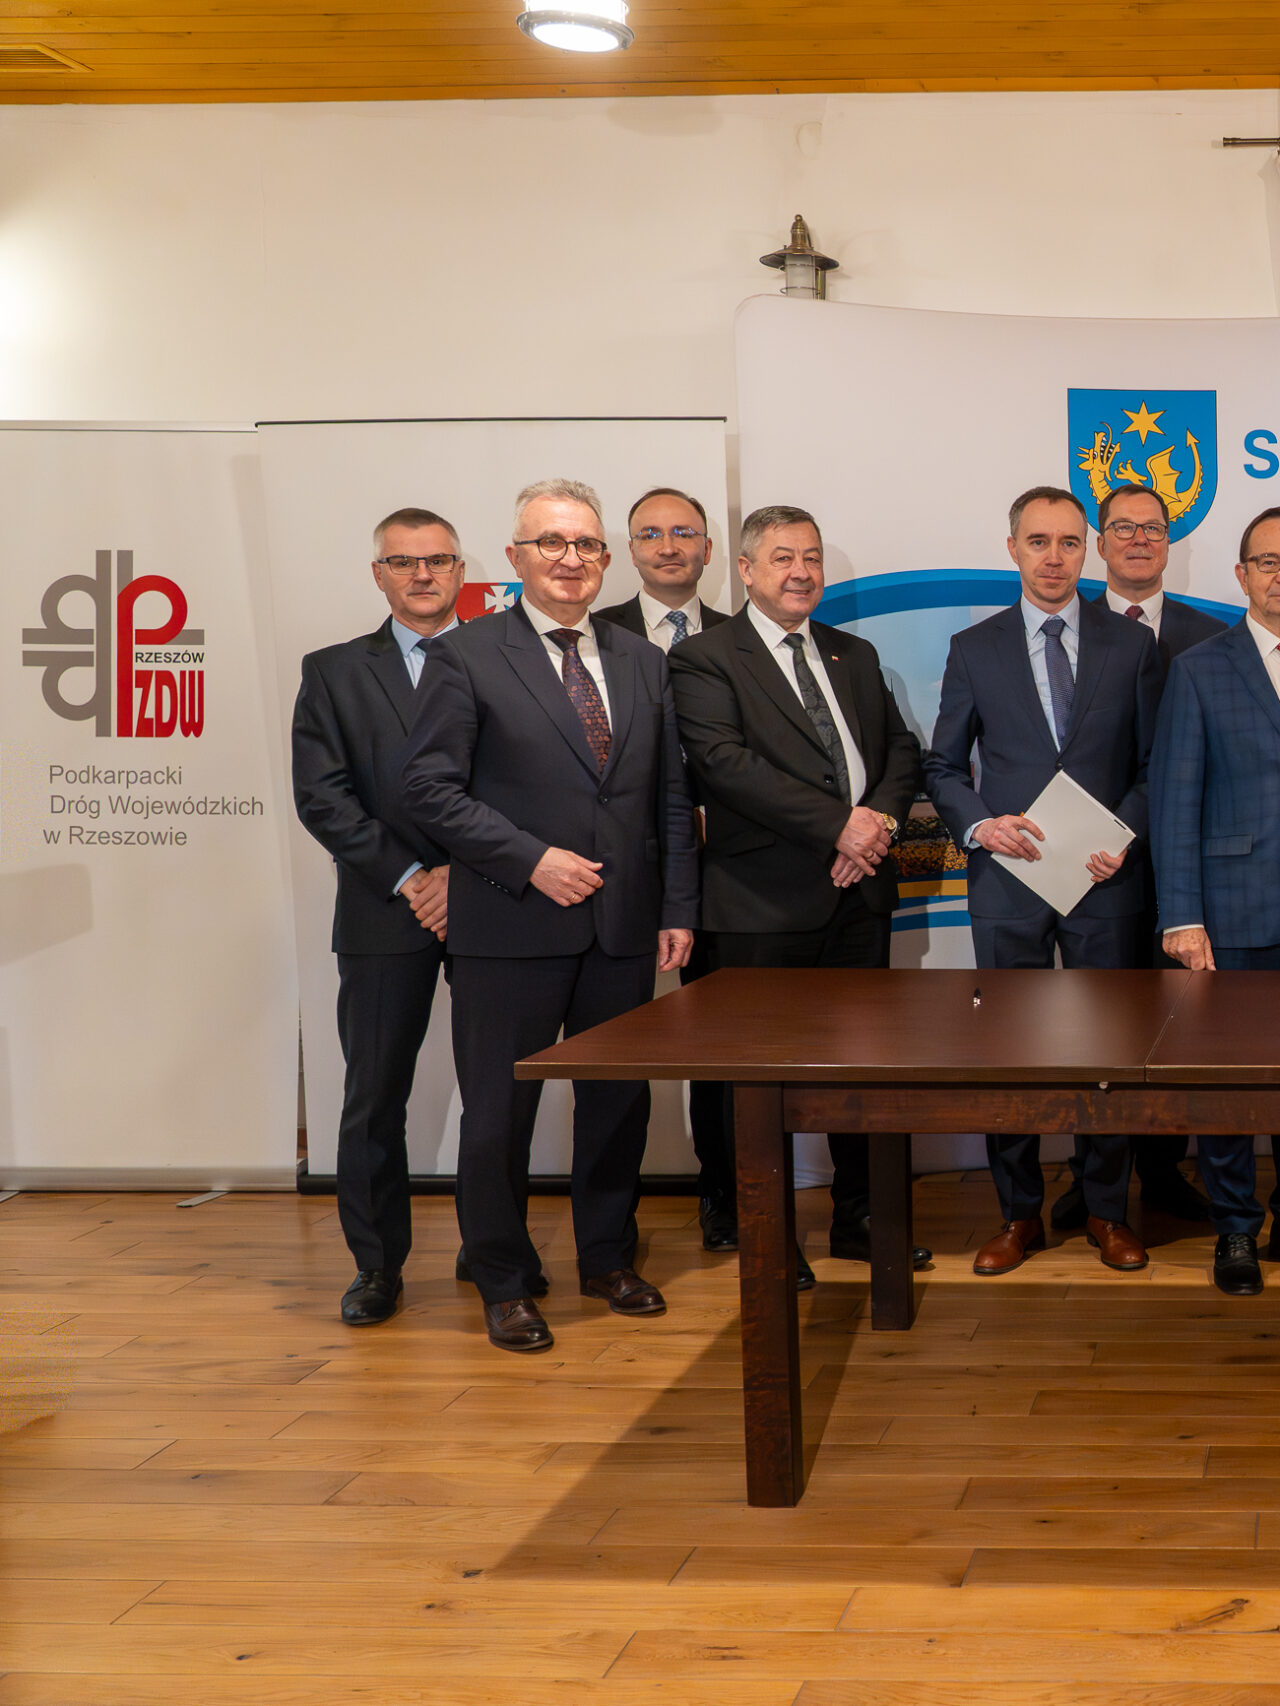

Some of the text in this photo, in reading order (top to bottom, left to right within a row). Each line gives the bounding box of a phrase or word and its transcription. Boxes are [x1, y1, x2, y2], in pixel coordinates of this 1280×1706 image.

[134, 650, 205, 664] RZESZÓW
[48, 764, 183, 789] Podkarpacki
[50, 794, 264, 820] Dróg Wojewódzkich
[42, 826, 188, 846] w Rzeszowie
